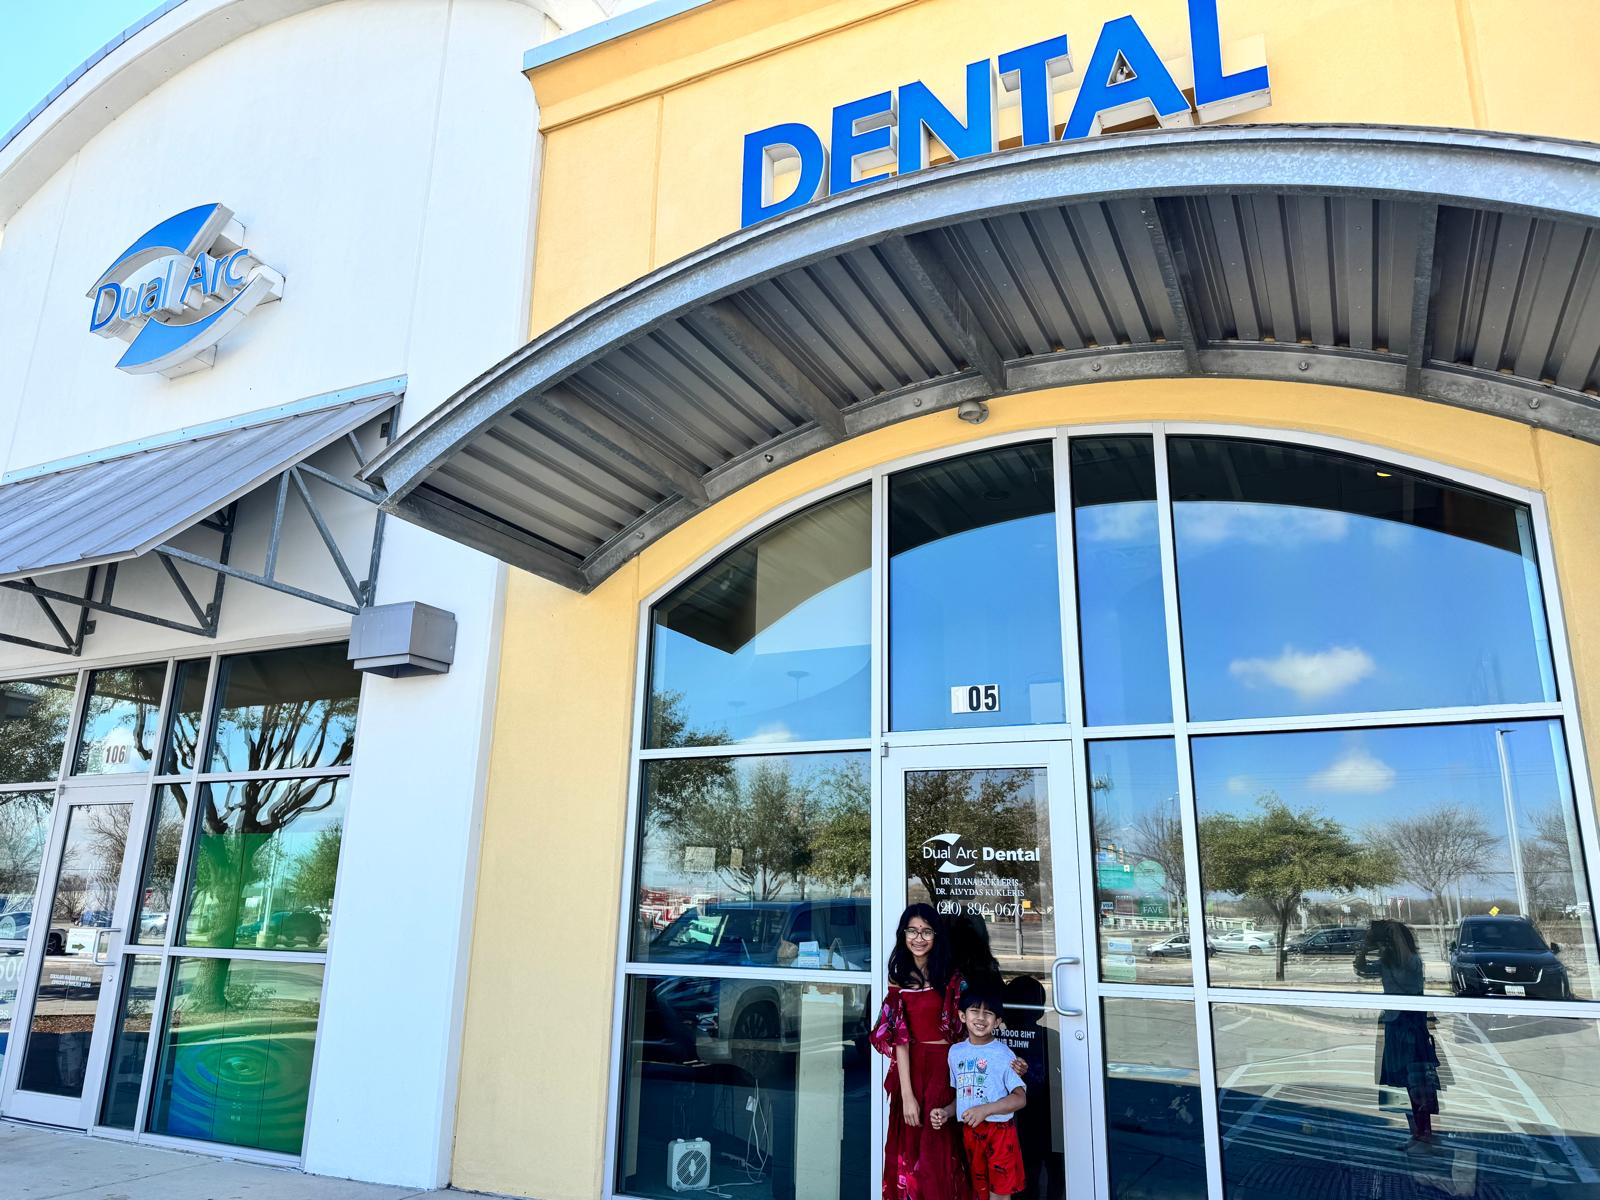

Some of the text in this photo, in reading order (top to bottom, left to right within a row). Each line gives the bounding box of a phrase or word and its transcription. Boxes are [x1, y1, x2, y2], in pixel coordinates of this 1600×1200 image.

[741, 0, 1270, 229] DENTAL
[89, 248, 249, 333] Dual Arc
[953, 685, 997, 711] 05
[105, 745, 126, 763] 106
[923, 846, 1040, 861] Dual Arc Dental
[940, 877, 1019, 887] DR. DIANA KUKLERIS
[935, 887, 1024, 897] DR. ALVYDAS KUKLERIS
[936, 900, 1024, 917] (210) 896-0670
